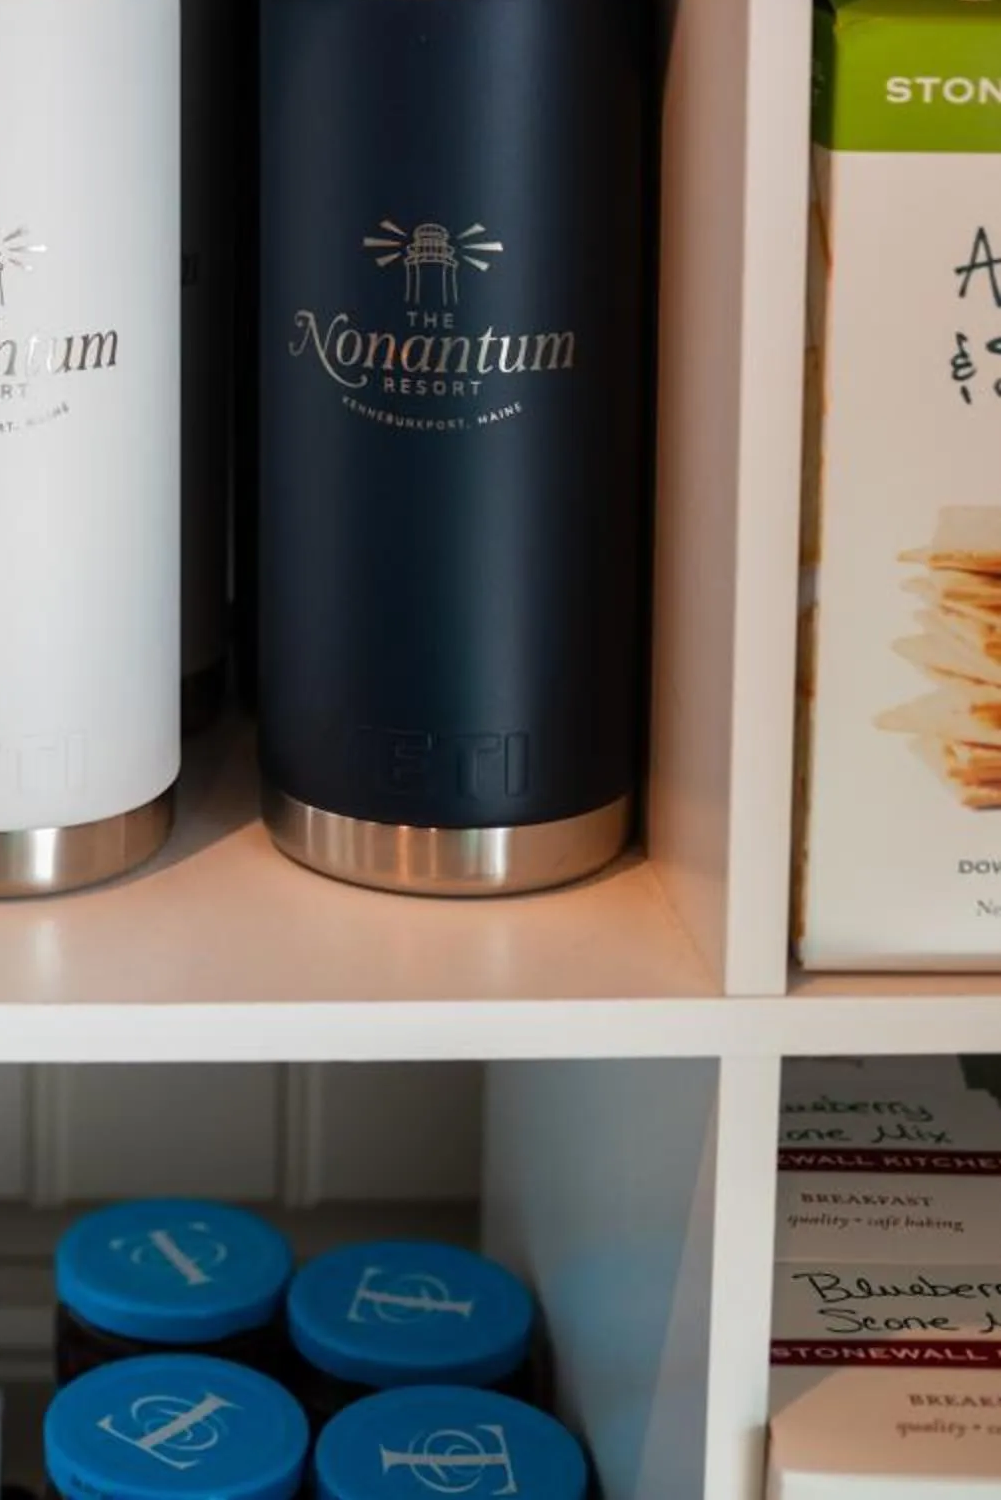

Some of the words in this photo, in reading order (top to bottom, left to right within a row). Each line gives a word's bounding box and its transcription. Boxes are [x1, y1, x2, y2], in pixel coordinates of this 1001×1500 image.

[406, 311, 455, 328] THE
[288, 309, 576, 388] Nonantum
[383, 377, 483, 396] RESORT
[478, 401, 522, 426] MAINE
[780, 1128, 852, 1143] one
[883, 1156, 1001, 1170] KITCHE
[800, 1192, 933, 1208] BREAKFAST
[787, 1213, 849, 1230] quality
[818, 1307, 960, 1334] Scone
[771, 1346, 988, 1361] STONEWALL
[908, 1393, 1001, 1408] BREAK
[896, 1418, 967, 1438] quality
